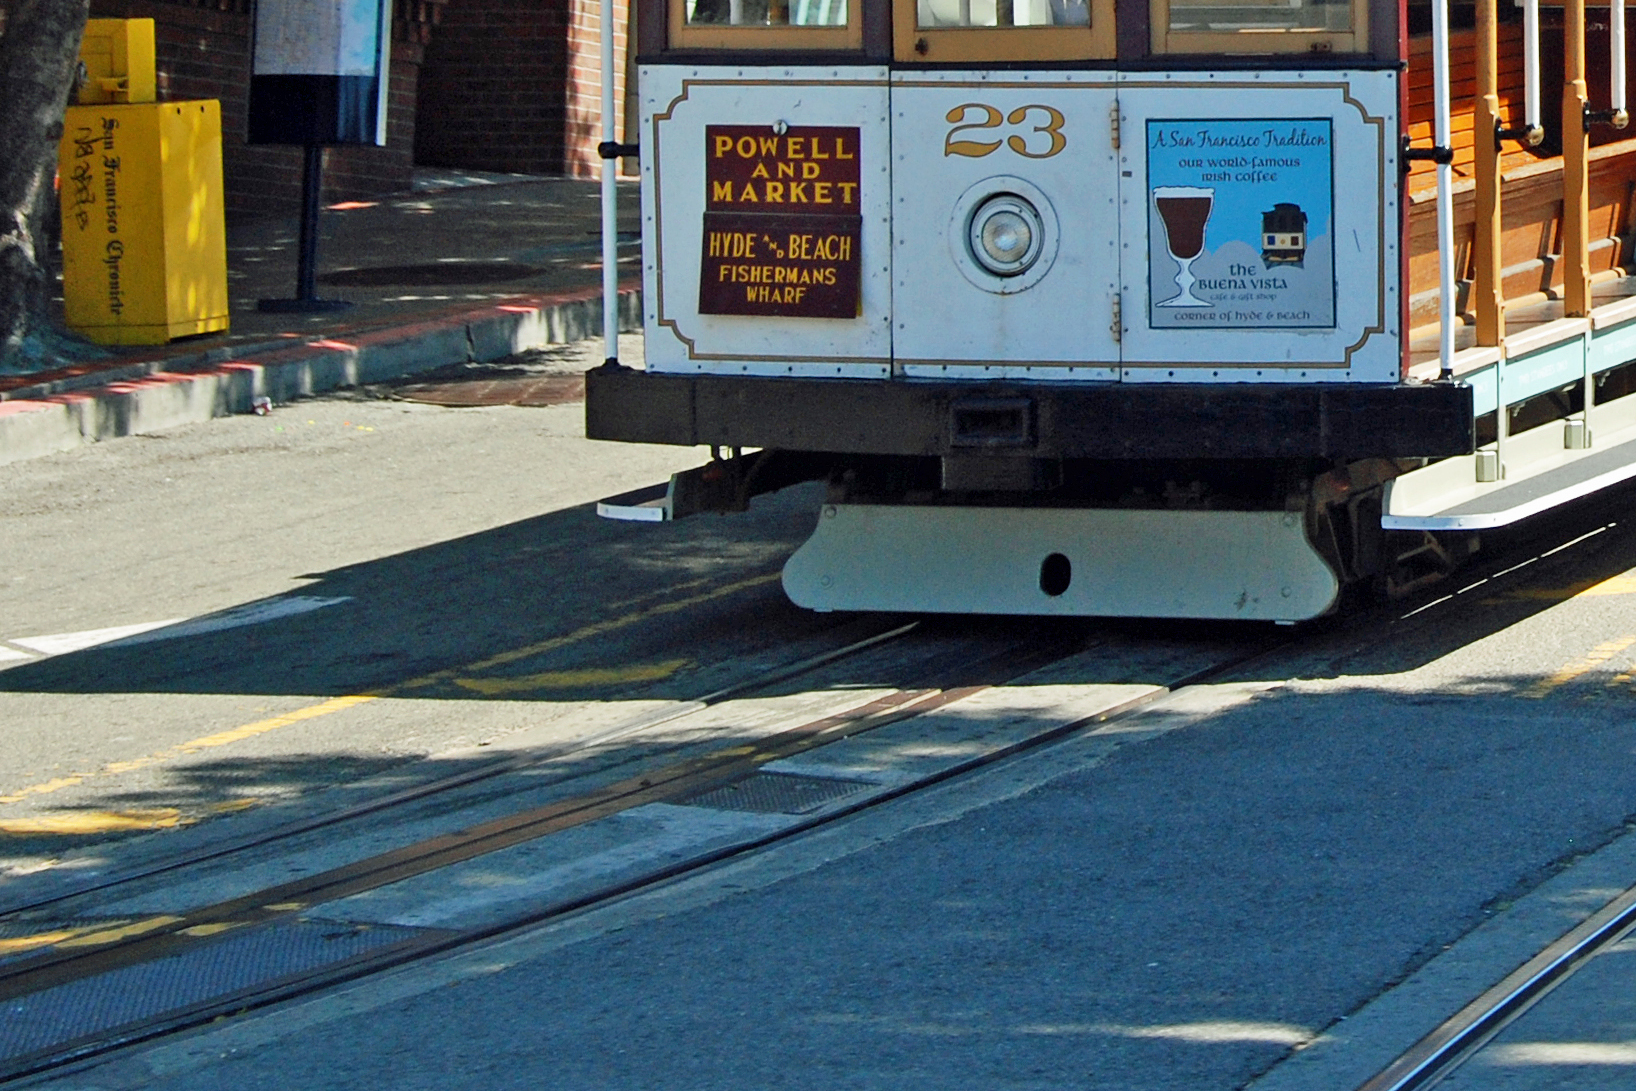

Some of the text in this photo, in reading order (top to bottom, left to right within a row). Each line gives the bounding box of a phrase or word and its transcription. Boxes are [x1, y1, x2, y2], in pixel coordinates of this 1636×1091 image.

[944, 102, 1067, 159] 23
[1151, 127, 1328, 149] A San Francisco Tradition
[714, 135, 854, 159] POWELL
[751, 161, 821, 179] AND
[712, 180, 858, 204] MARKET
[101, 116, 125, 317] San Francisco Chronicle
[708, 231, 852, 261] HYDE AND BEACH
[718, 264, 837, 286] FISHERMANS
[746, 285, 807, 304] WHARF
